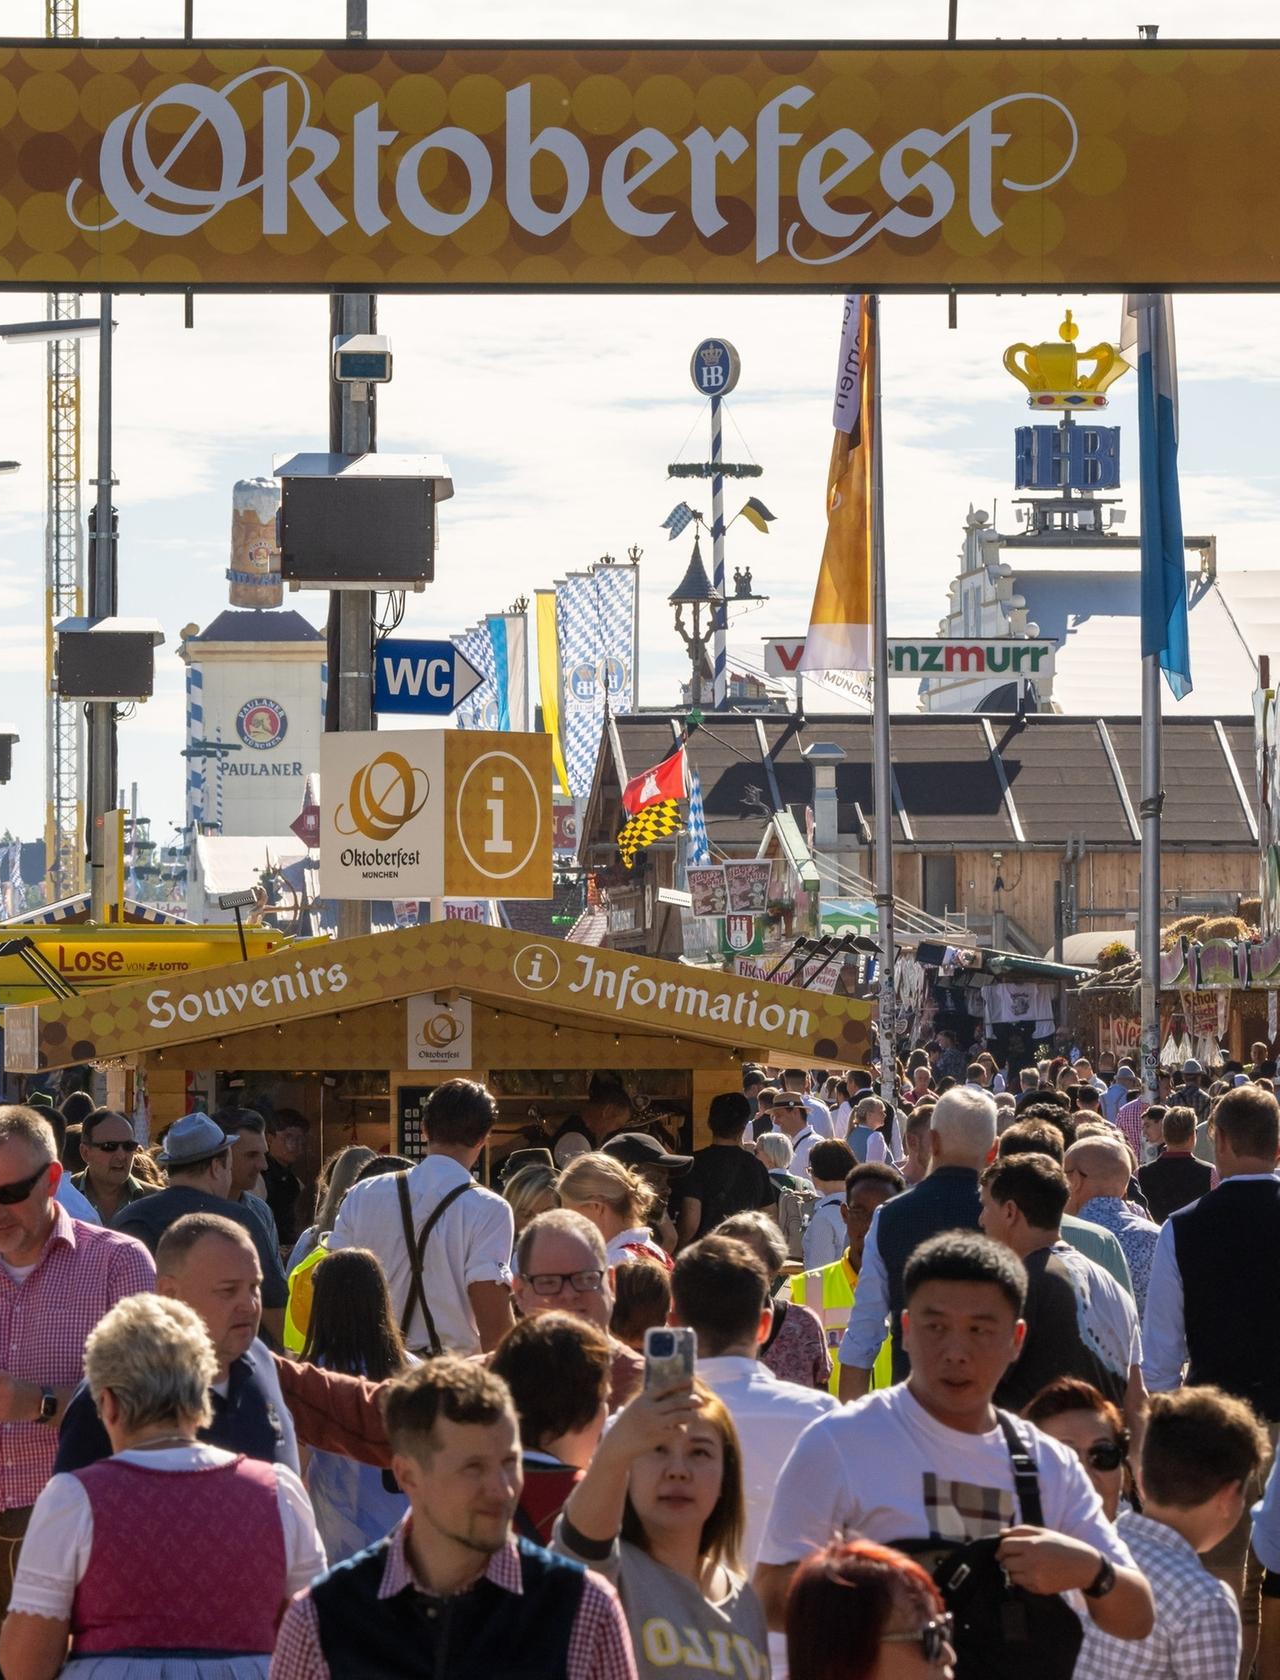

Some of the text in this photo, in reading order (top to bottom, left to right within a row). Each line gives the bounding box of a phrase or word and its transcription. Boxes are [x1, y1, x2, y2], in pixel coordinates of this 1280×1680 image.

[66, 66, 1078, 265] Oktoberfest
[702, 366, 723, 387] HB
[1030, 424, 1120, 490] HB
[775, 645, 1048, 673] vnzmurr
[384, 658, 451, 697] WC
[824, 671, 872, 704] MÜNCHE
[239, 699, 285, 719] PAULANER
[243, 736, 281, 749] MÜNCHEN
[221, 762, 303, 776] PAULANER
[340, 849, 420, 870] Oktoberfest
[362, 869, 399, 879] MÜNCHEN
[59, 945, 189, 972] Lose VON LOTTO
[146, 960, 348, 1029] Souvenirs
[569, 955, 811, 1038] Information
[418, 1050, 460, 1060] Oktoberfest
